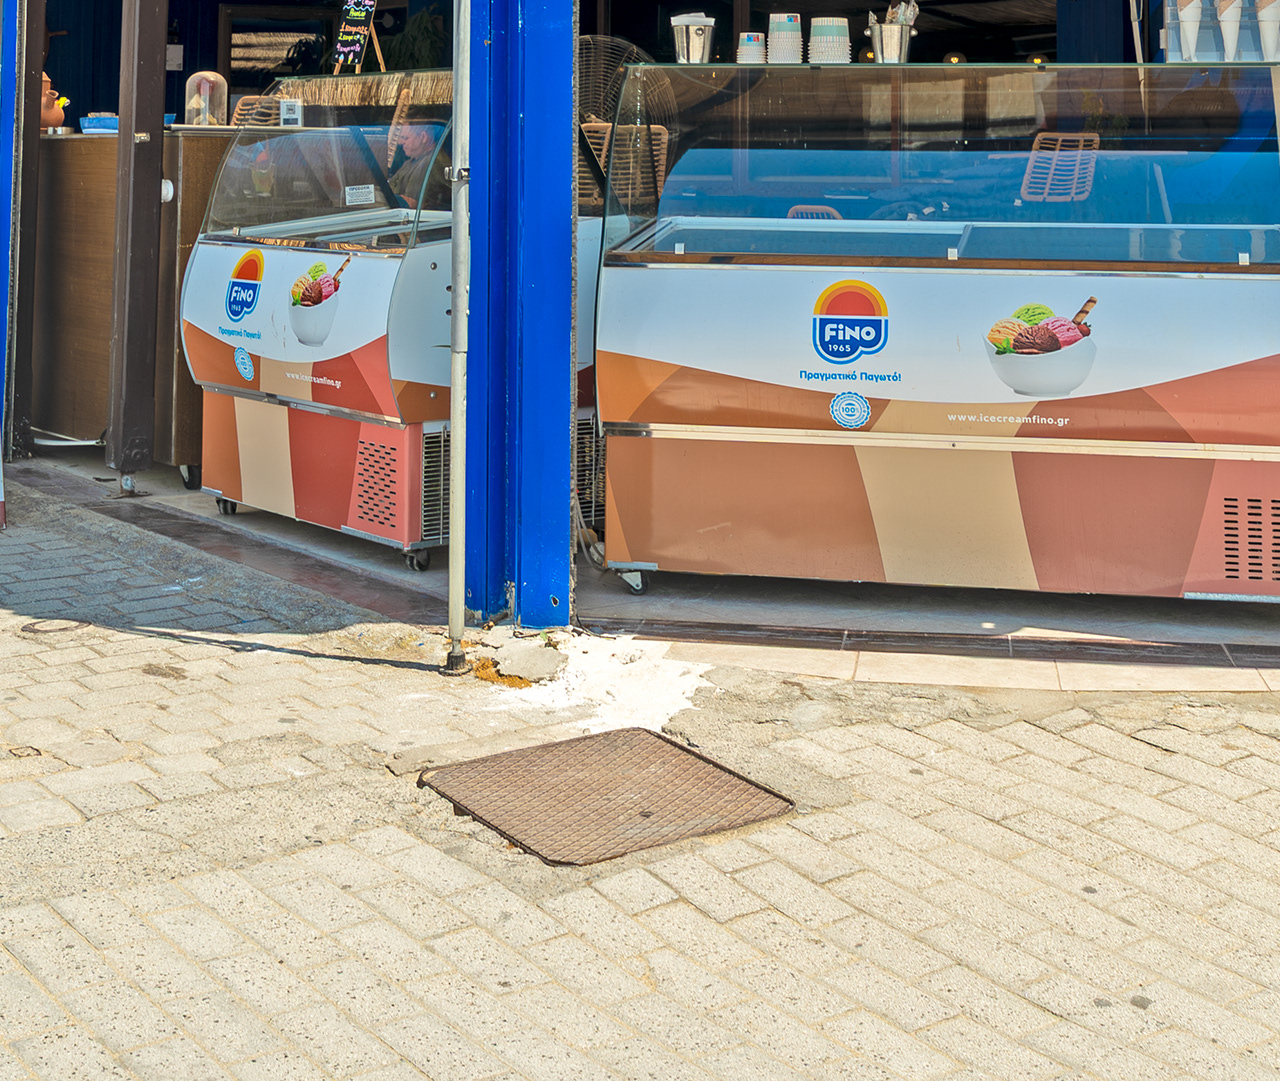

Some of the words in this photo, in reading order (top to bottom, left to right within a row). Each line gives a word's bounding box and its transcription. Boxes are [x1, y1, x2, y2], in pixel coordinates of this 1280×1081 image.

[230, 286, 254, 302] FiNO
[824, 324, 876, 342] FiNO
[829, 344, 851, 352] 1965
[285, 372, 342, 389] www.icecreamfino.gr
[800, 370, 857, 381] Πραγματικό
[860, 372, 902, 383] Παγωτό!
[948, 413, 1069, 427] www.icecreamfino.gr
